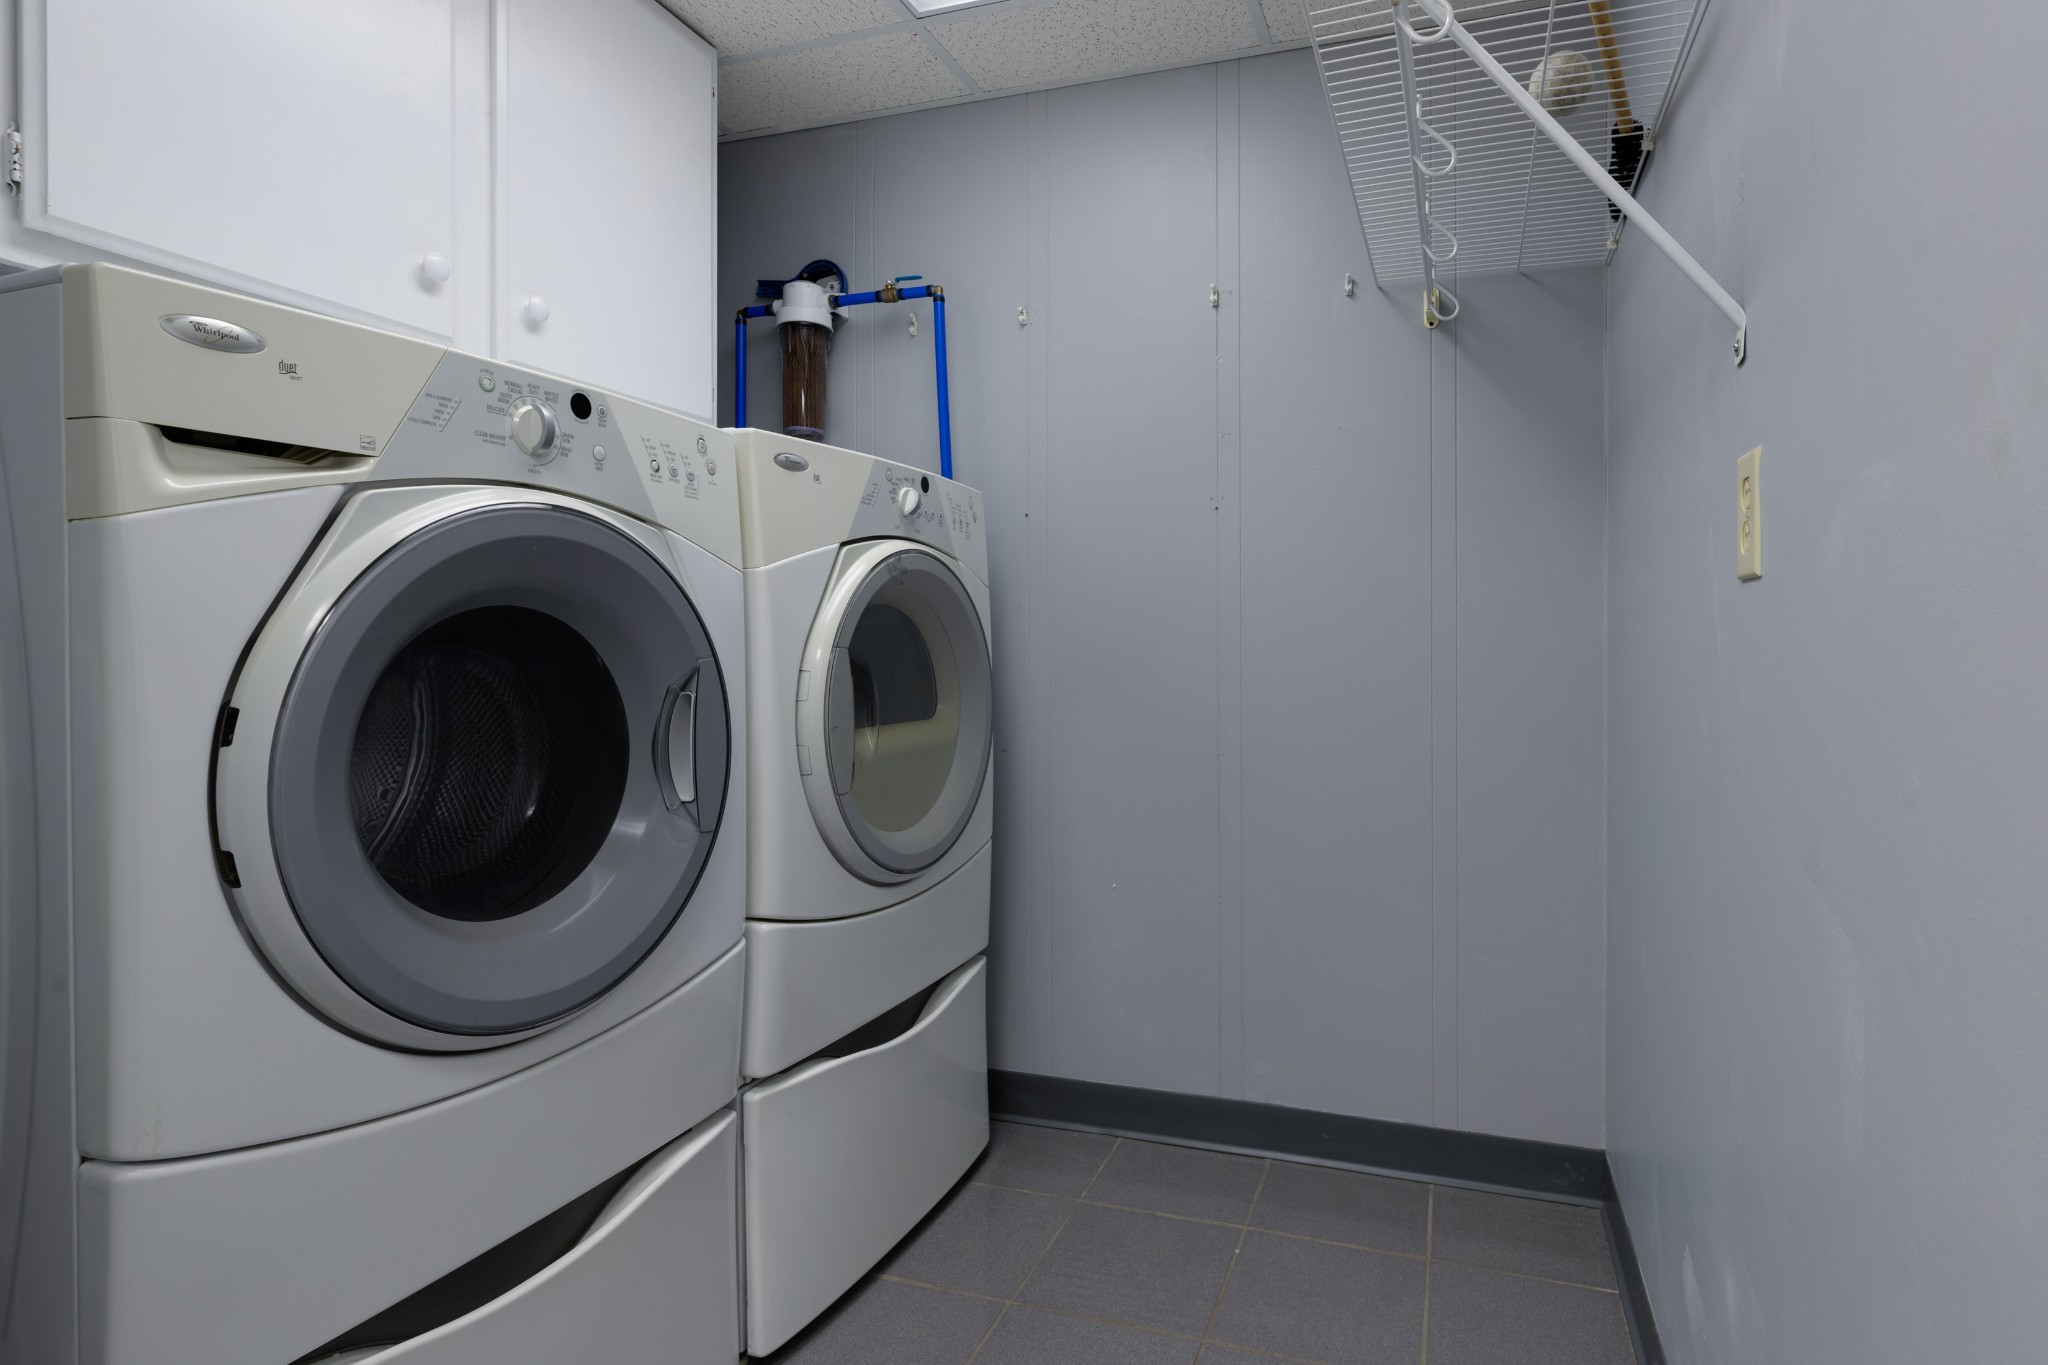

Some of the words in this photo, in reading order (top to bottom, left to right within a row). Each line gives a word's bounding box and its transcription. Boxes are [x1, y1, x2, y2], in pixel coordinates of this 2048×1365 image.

[192, 324, 240, 341] Whirlpool
[278, 359, 298, 375] duet
[486, 404, 505, 413] DELICATE
